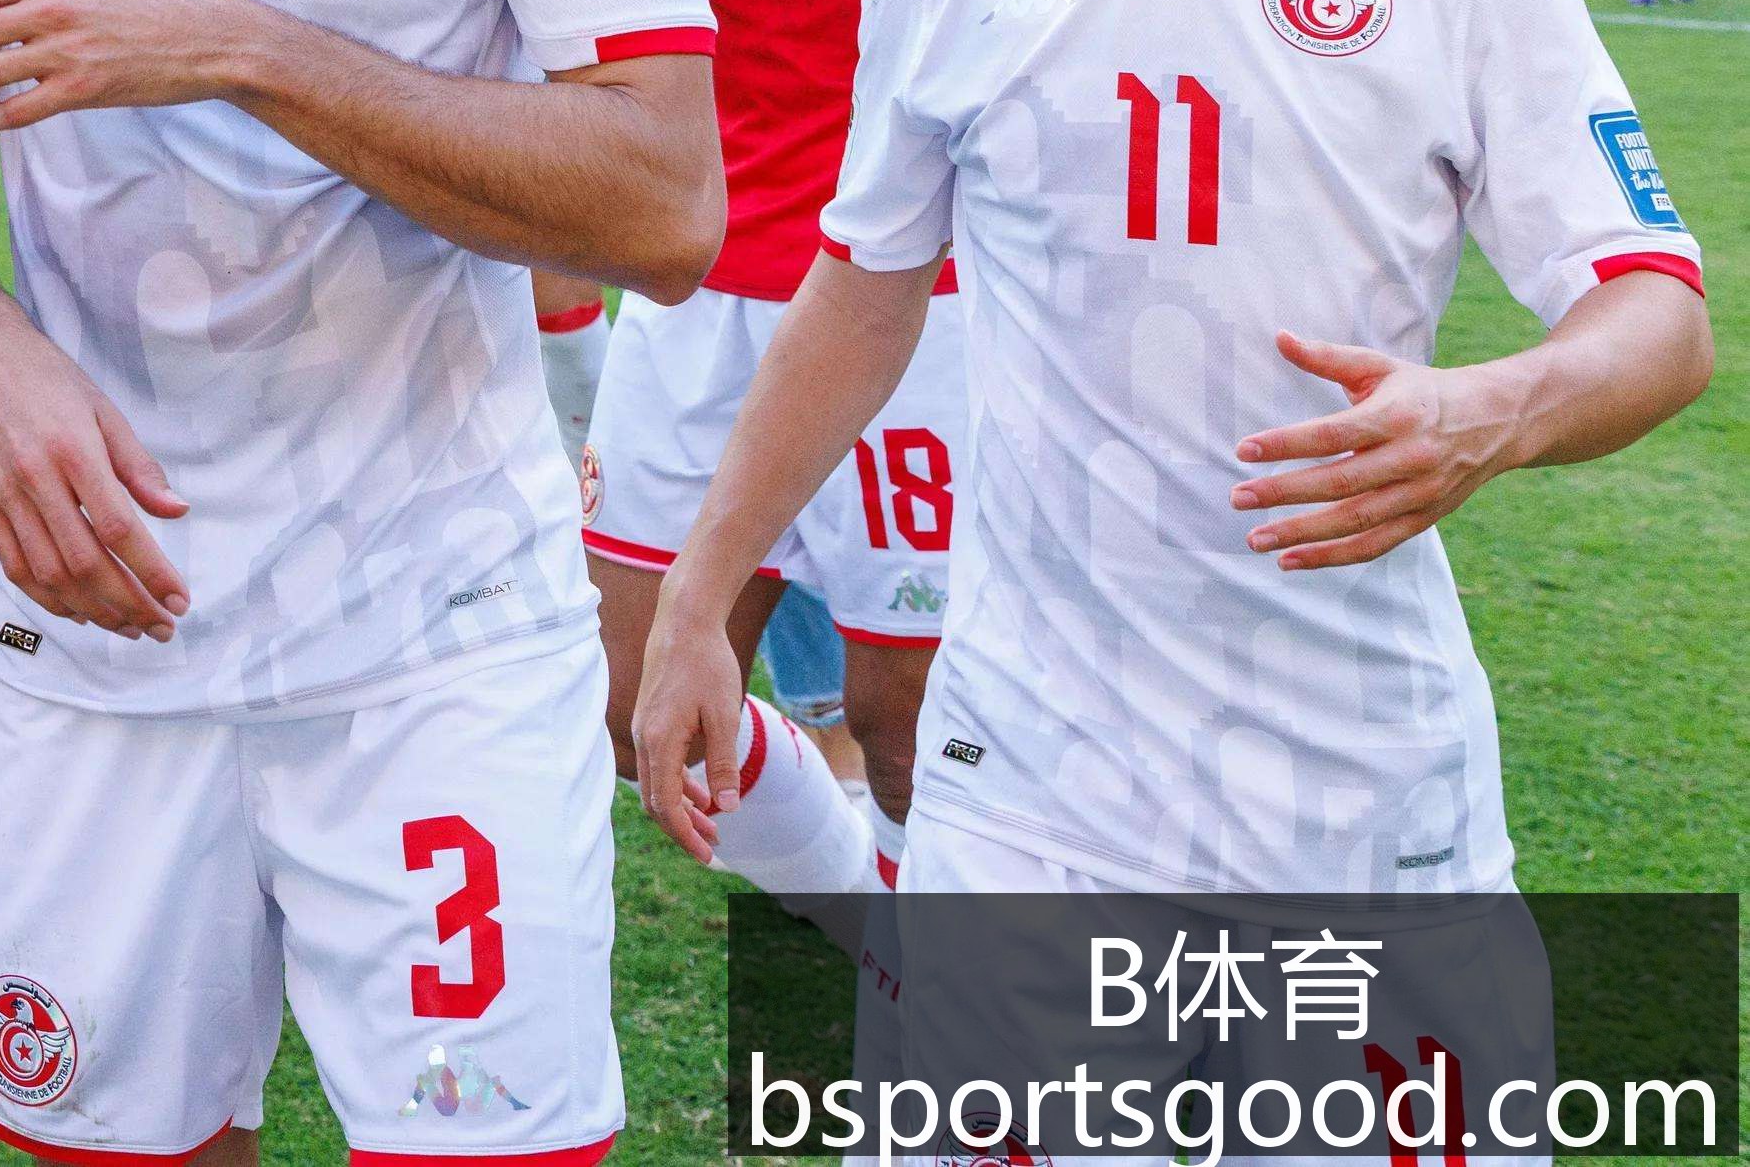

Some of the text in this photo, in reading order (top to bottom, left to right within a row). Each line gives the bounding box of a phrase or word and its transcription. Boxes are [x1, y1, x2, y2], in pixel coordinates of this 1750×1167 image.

[1295, 34, 1349, 50] TUNISIENNE
[1351, 38, 1362, 47] DE
[1361, 7, 1386, 41] FOOTBALL
[1118, 72, 1221, 246] 11
[854, 428, 954, 551] 18
[450, 581, 513, 607] KOMBAT
[403, 815, 505, 1019] 3
[38, 1089, 49, 1098] DE
[48, 1057, 72, 1093] FOOTBALL
